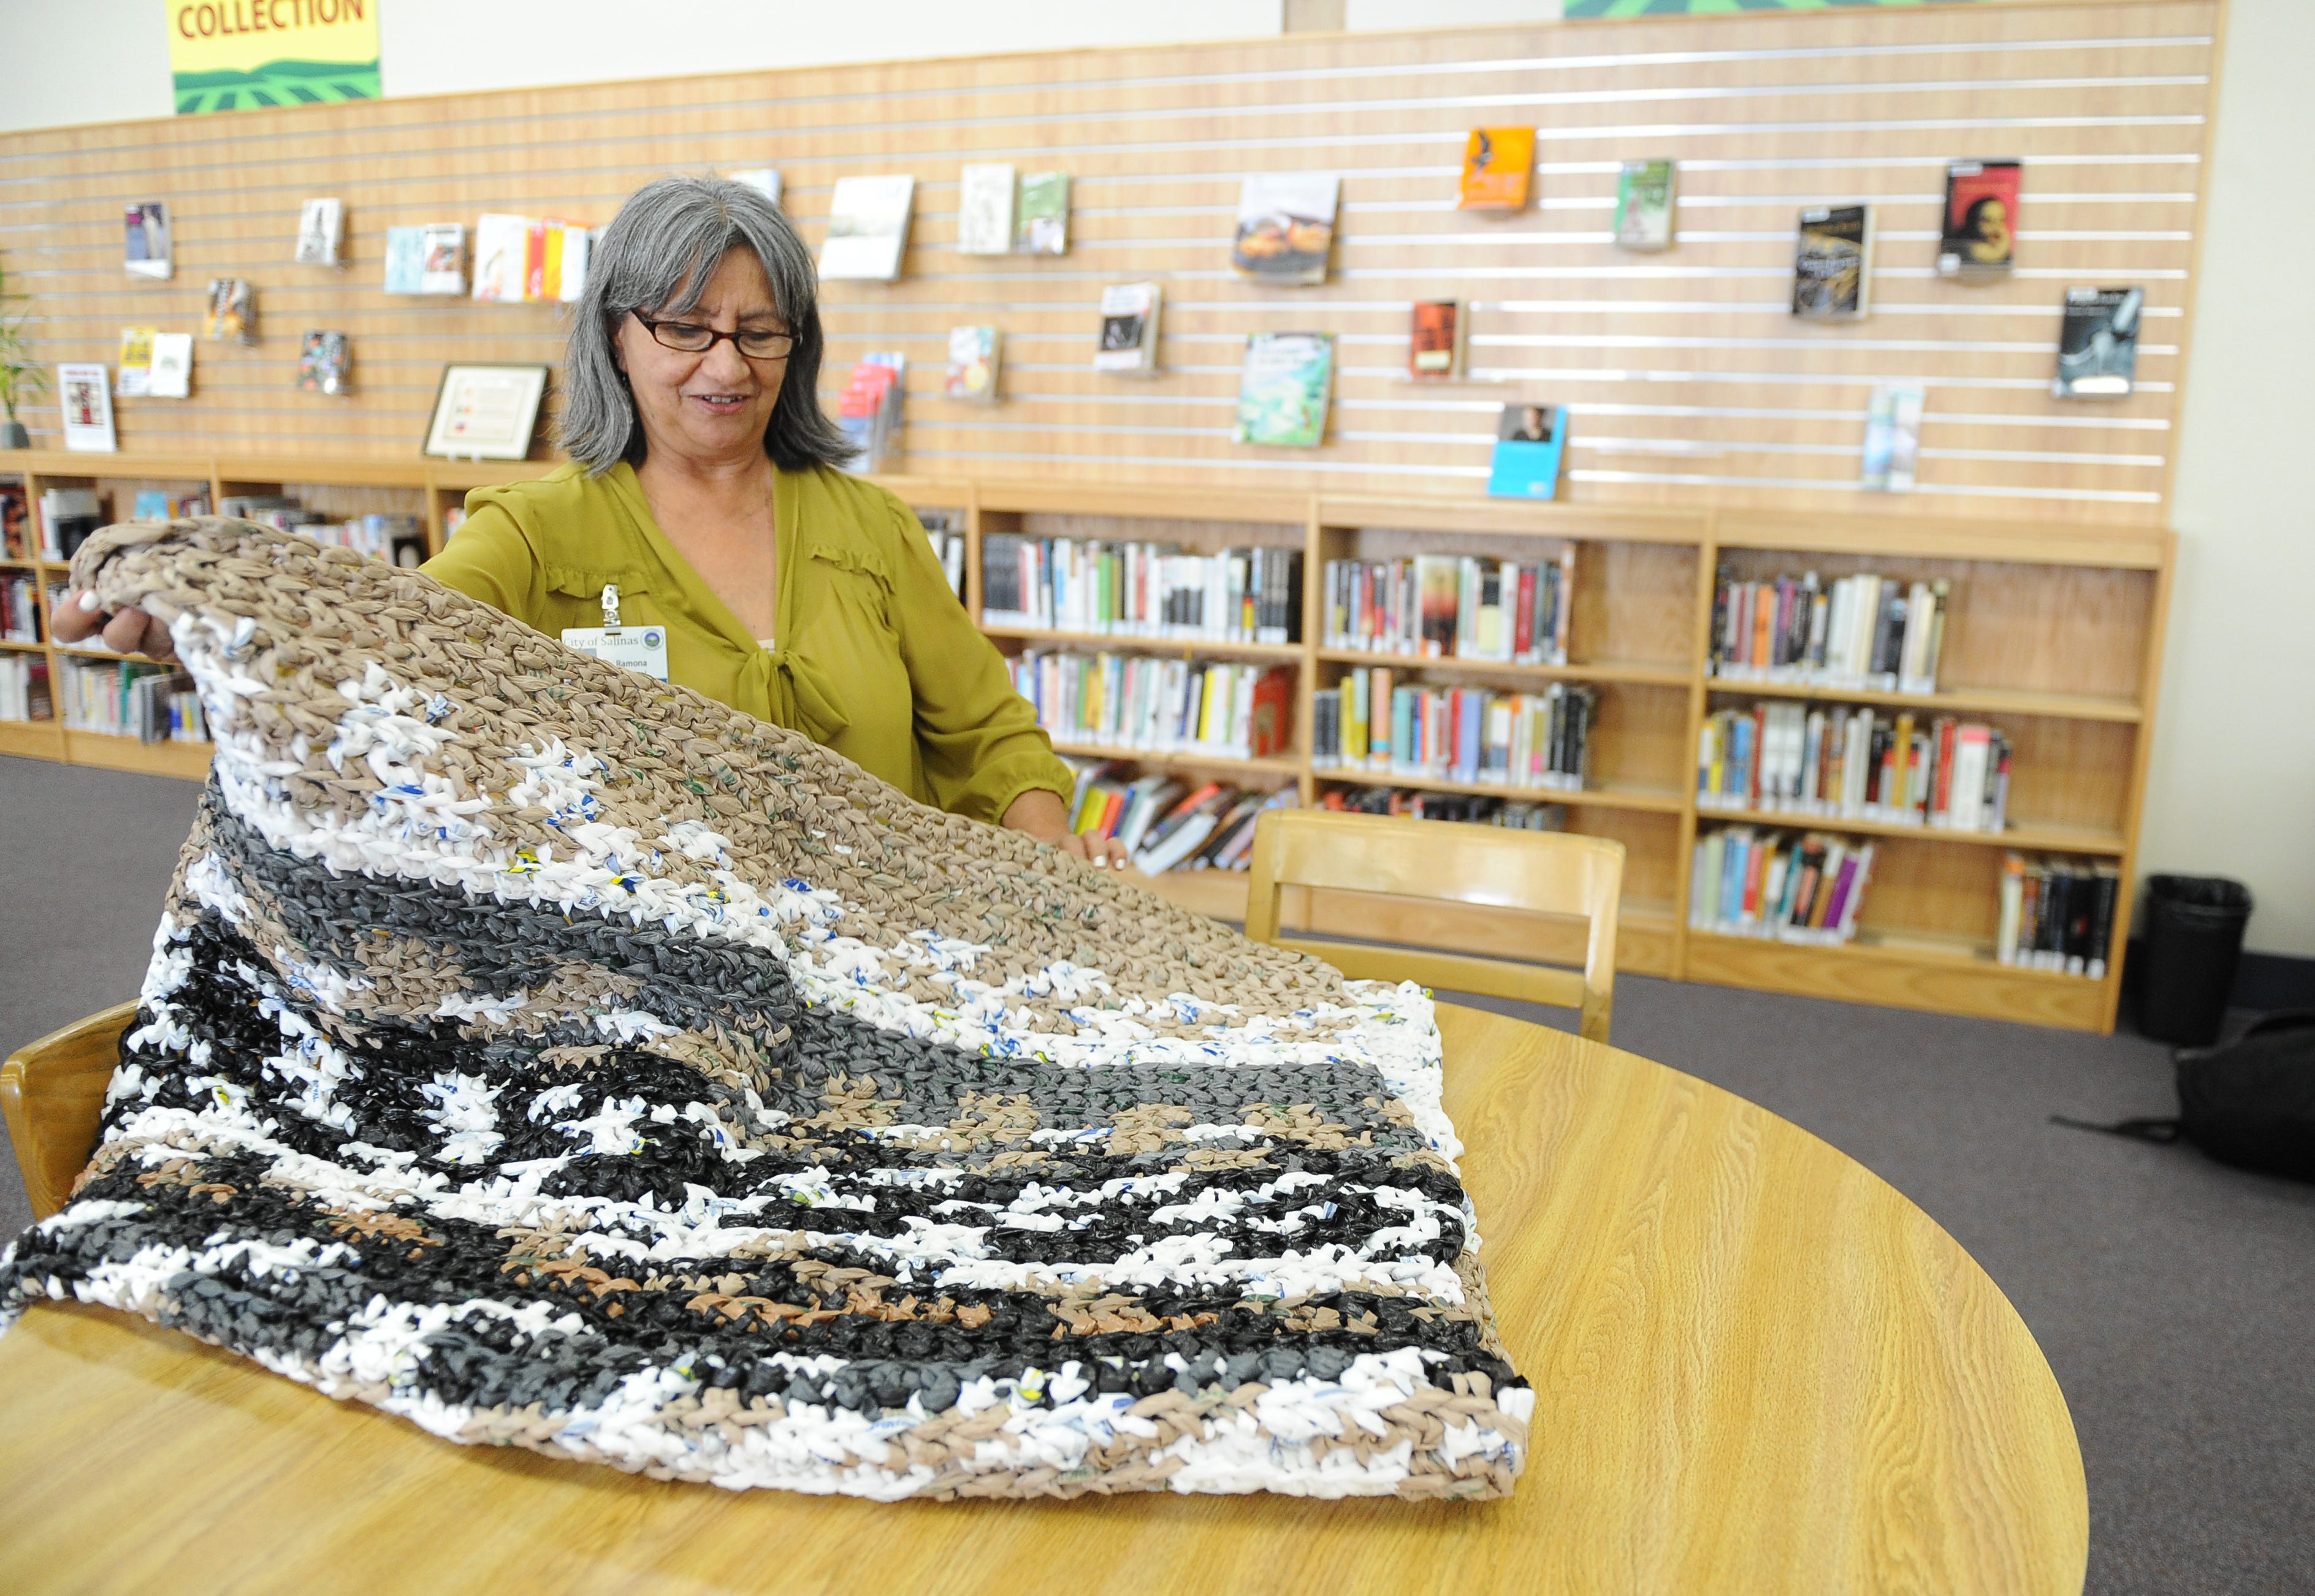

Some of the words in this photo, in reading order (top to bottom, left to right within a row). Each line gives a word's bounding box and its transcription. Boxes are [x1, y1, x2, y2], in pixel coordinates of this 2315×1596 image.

[178, 0, 363, 38] COLLECTION
[564, 636, 585, 647] City
[587, 637, 599, 646] of
[601, 636, 638, 646] Salinas
